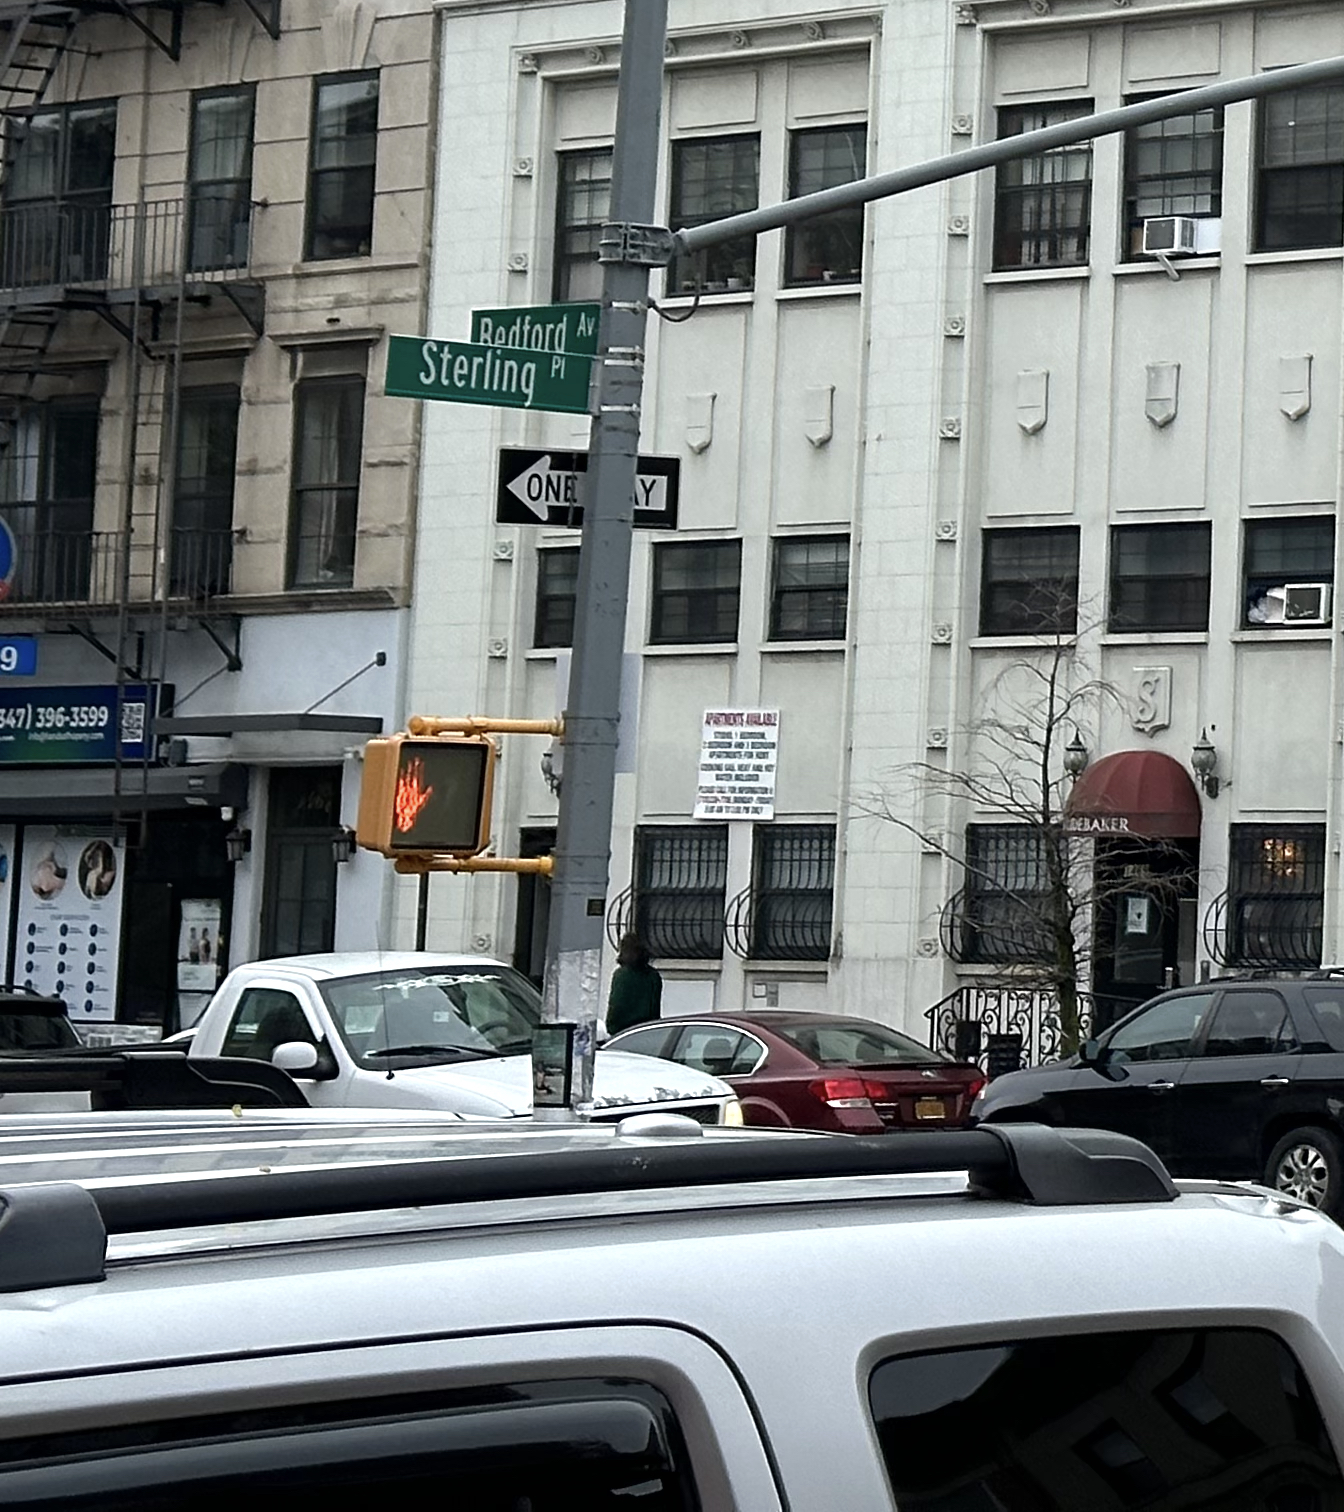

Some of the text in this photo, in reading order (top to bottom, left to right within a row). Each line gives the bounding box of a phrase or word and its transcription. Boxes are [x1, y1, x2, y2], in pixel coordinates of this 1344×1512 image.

[479, 312, 595, 353] Bedford Av
[419, 341, 566, 407] Sterling Pl
[526, 473, 578, 503] ONE
[36, 705, 108, 728] 396-3599
